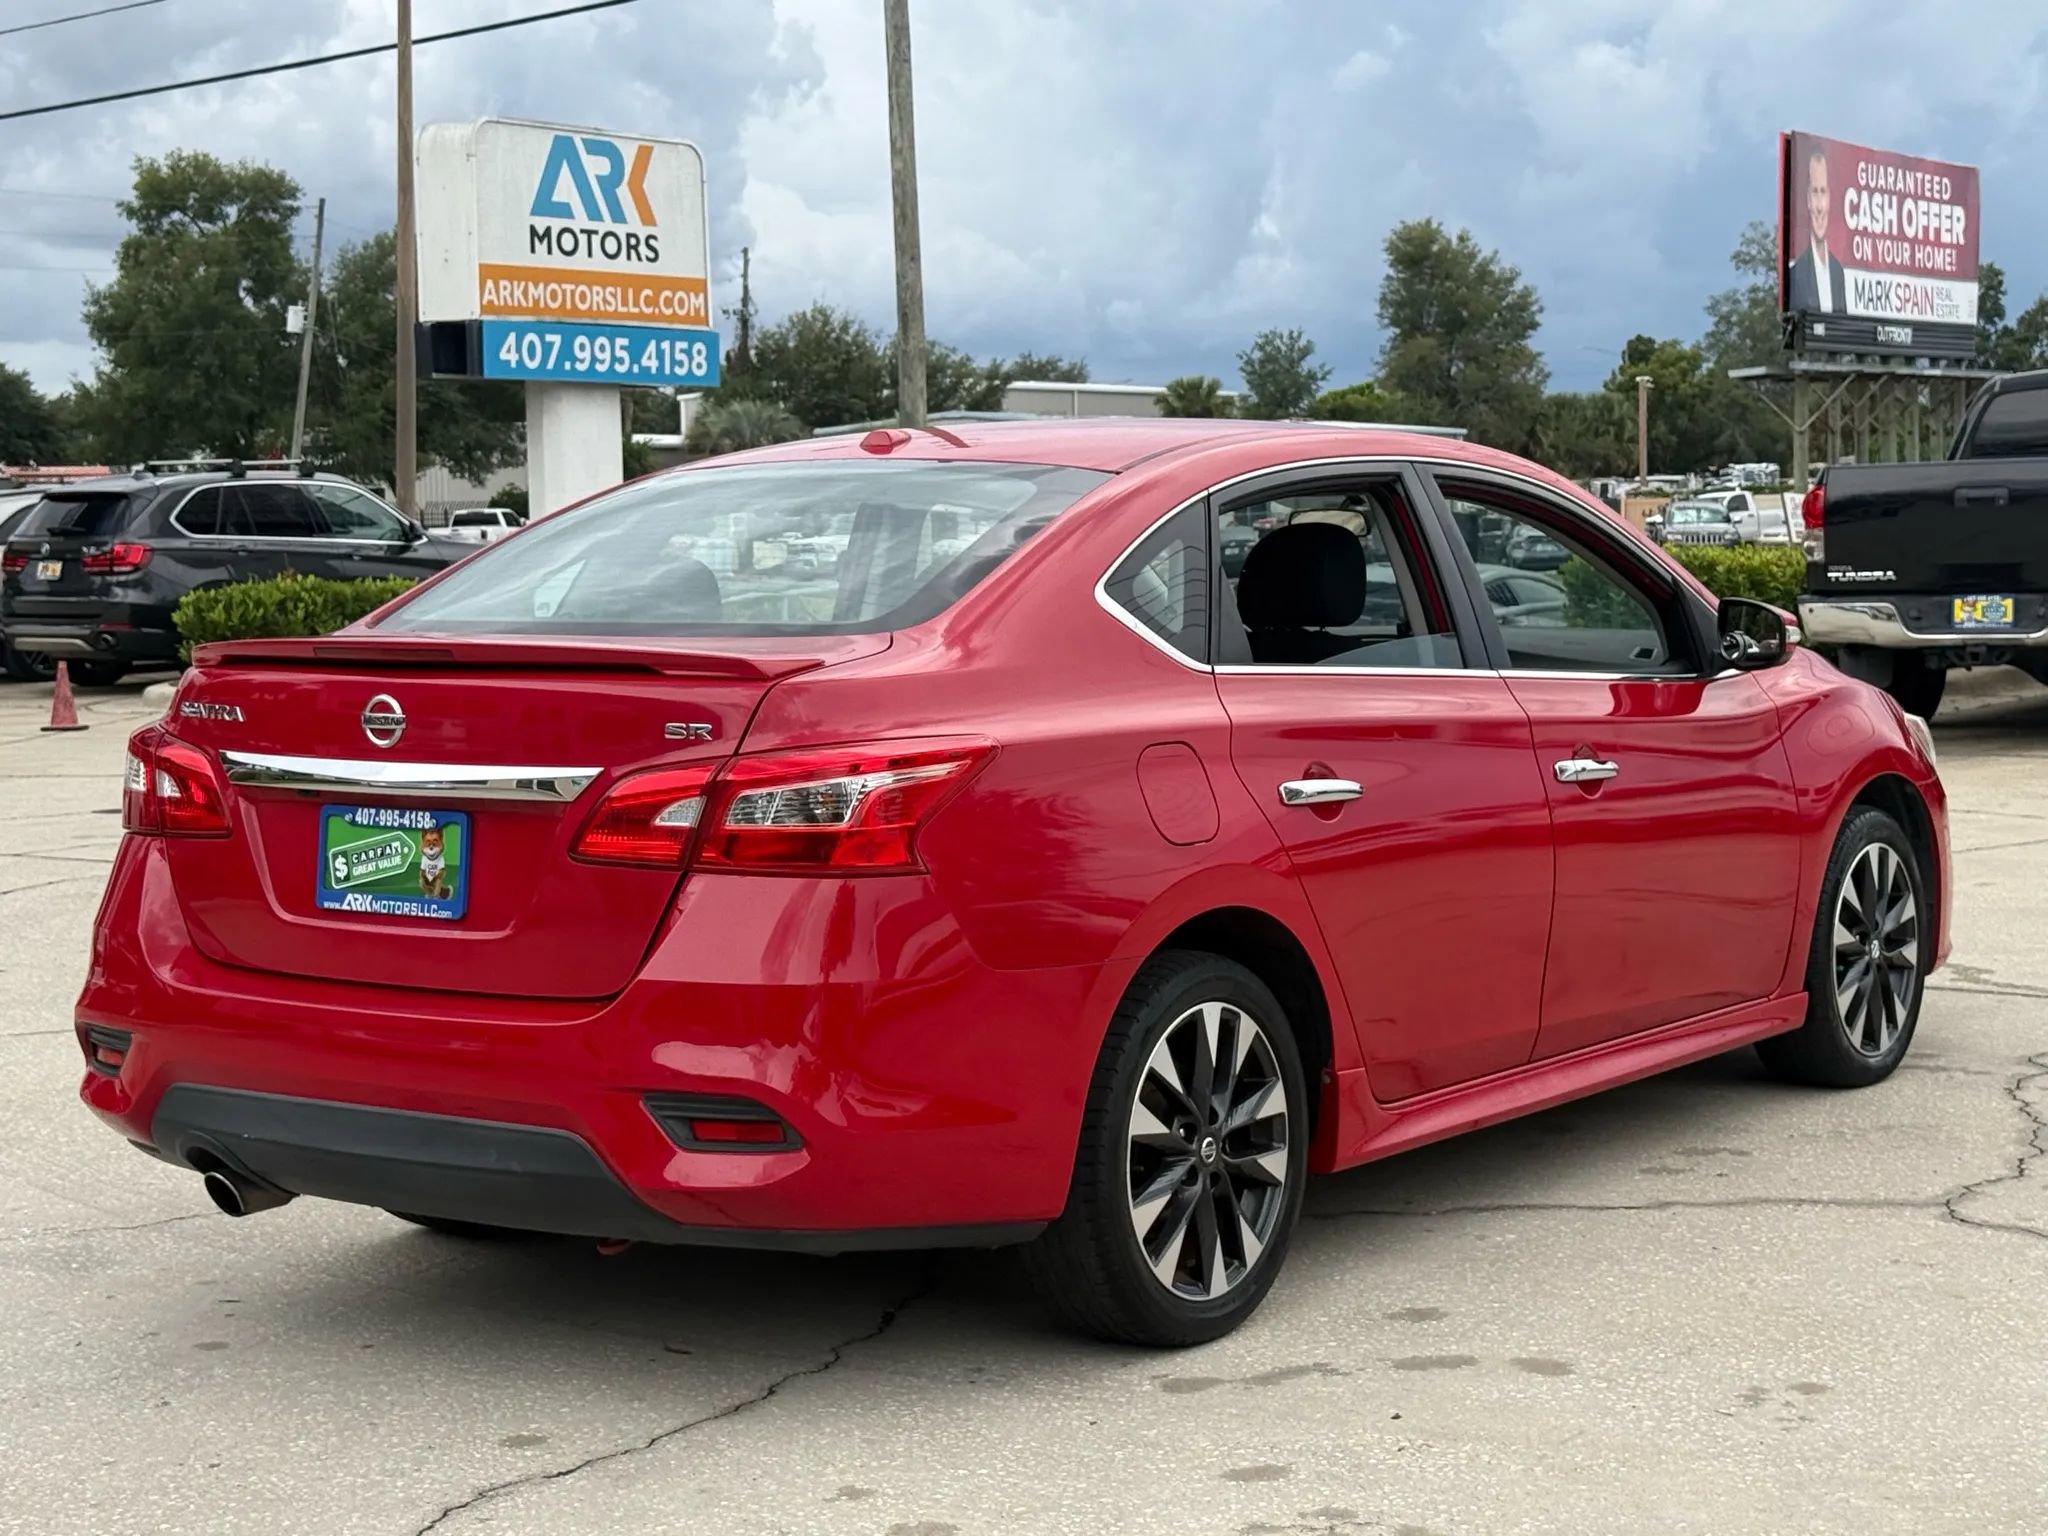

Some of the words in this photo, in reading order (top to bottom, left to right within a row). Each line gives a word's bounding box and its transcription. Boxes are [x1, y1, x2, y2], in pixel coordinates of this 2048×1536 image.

[529, 134, 658, 227] ARK
[1857, 161, 1951, 200] GUARANTEED
[1844, 187, 1897, 235] CASH
[1902, 197, 1966, 245] OFFER
[529, 224, 660, 263] MOTORS
[1853, 234, 1873, 262] ON
[1876, 239, 1911, 267] YOUR
[1915, 244, 1958, 272] HOME!
[482, 278, 705, 317] ARKMOTORSLLC.COM
[499, 331, 709, 377] 407.995.4158
[1827, 570, 1896, 582] TUNDRA
[180, 701, 244, 722] SENTRA
[664, 722, 713, 741] SR
[355, 808, 431, 828] 407-995-4158
[352, 842, 401, 864] CARFAX
[352, 862, 377, 877] GREAT
[378, 856, 402, 869] VALUE
